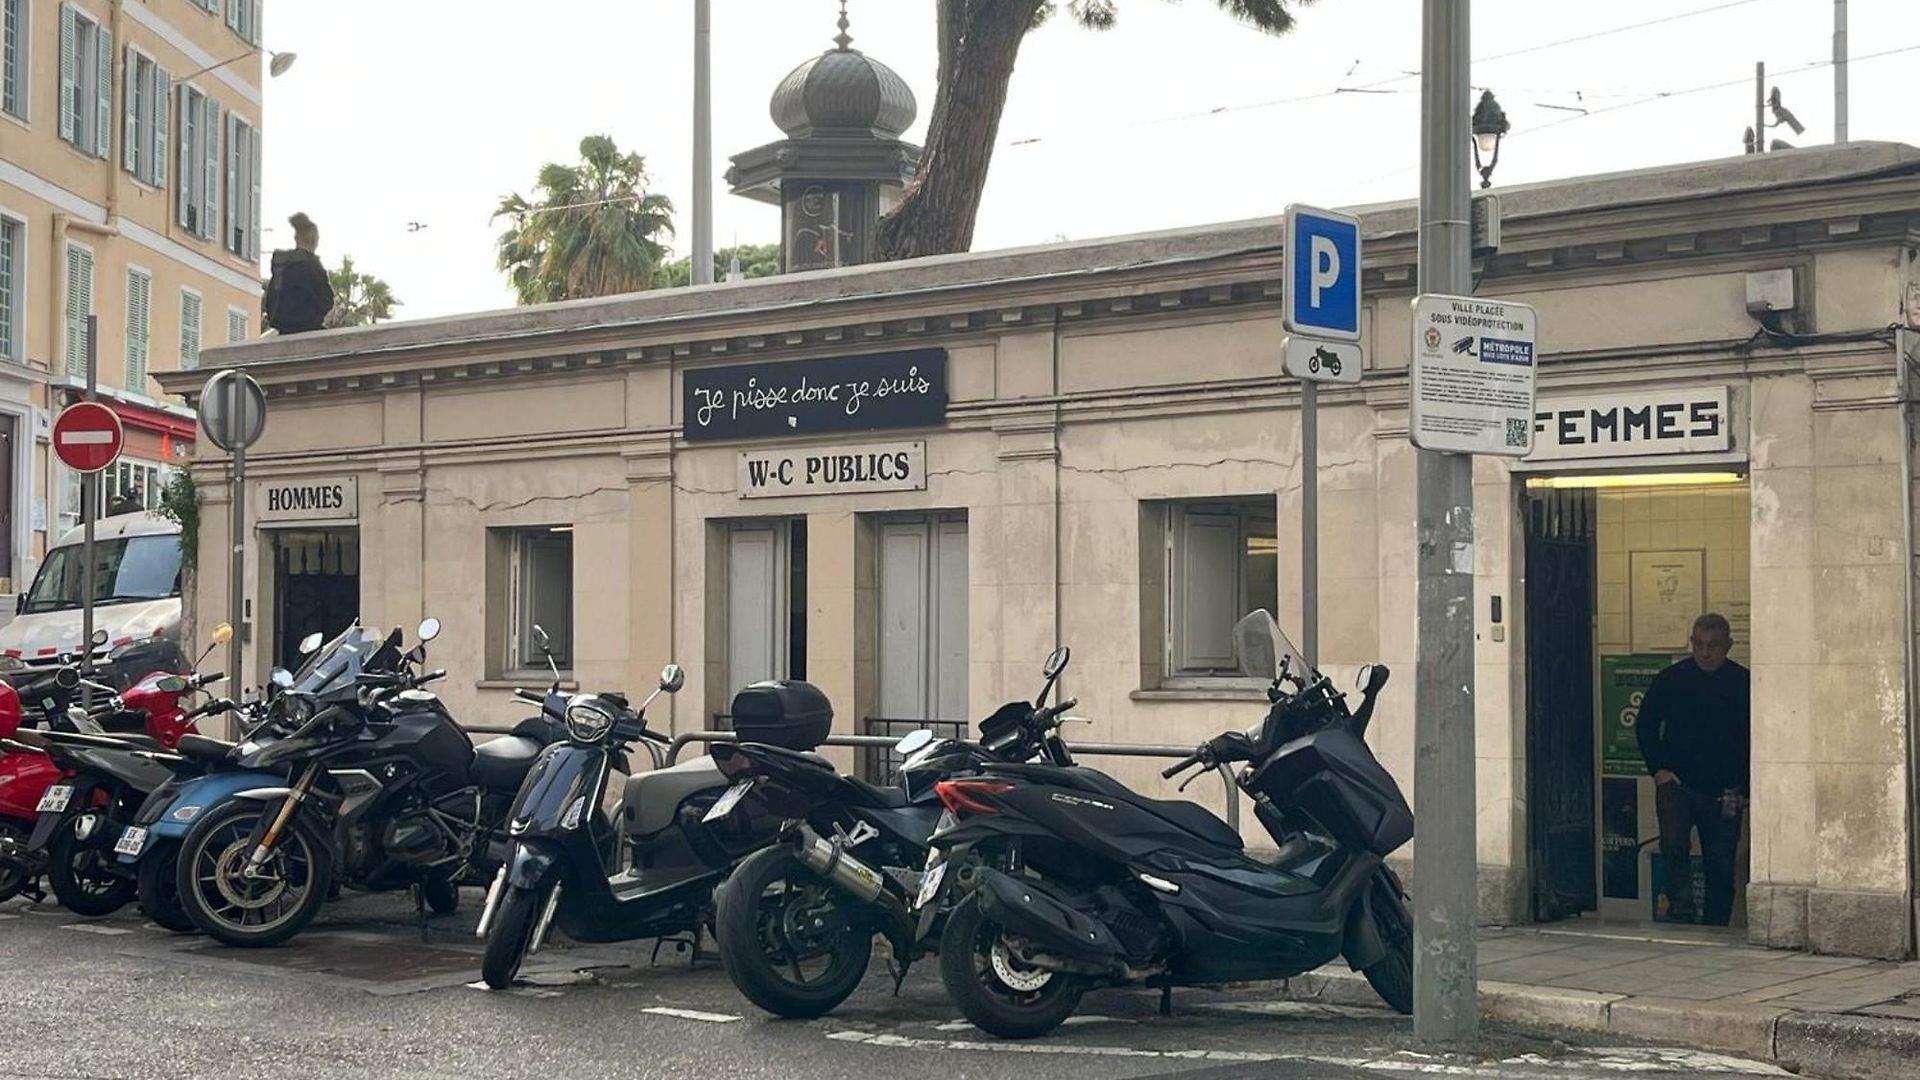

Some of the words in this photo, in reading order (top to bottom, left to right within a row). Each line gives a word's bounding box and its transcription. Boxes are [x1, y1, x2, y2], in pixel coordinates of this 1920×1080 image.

[1310, 235, 1341, 309] P
[1430, 312, 1452, 324] SOUS
[1454, 315, 1524, 332] VIDÉOPROTECTION
[1452, 302, 1474, 314] VILLE
[1475, 304, 1505, 317] PLACÉE
[732, 377, 788, 420] pisse
[791, 376, 840, 404] donc
[872, 365, 931, 397] suis
[748, 458, 794, 487] W-C
[805, 452, 910, 485] PUBLICS
[268, 485, 344, 511] HOMMES
